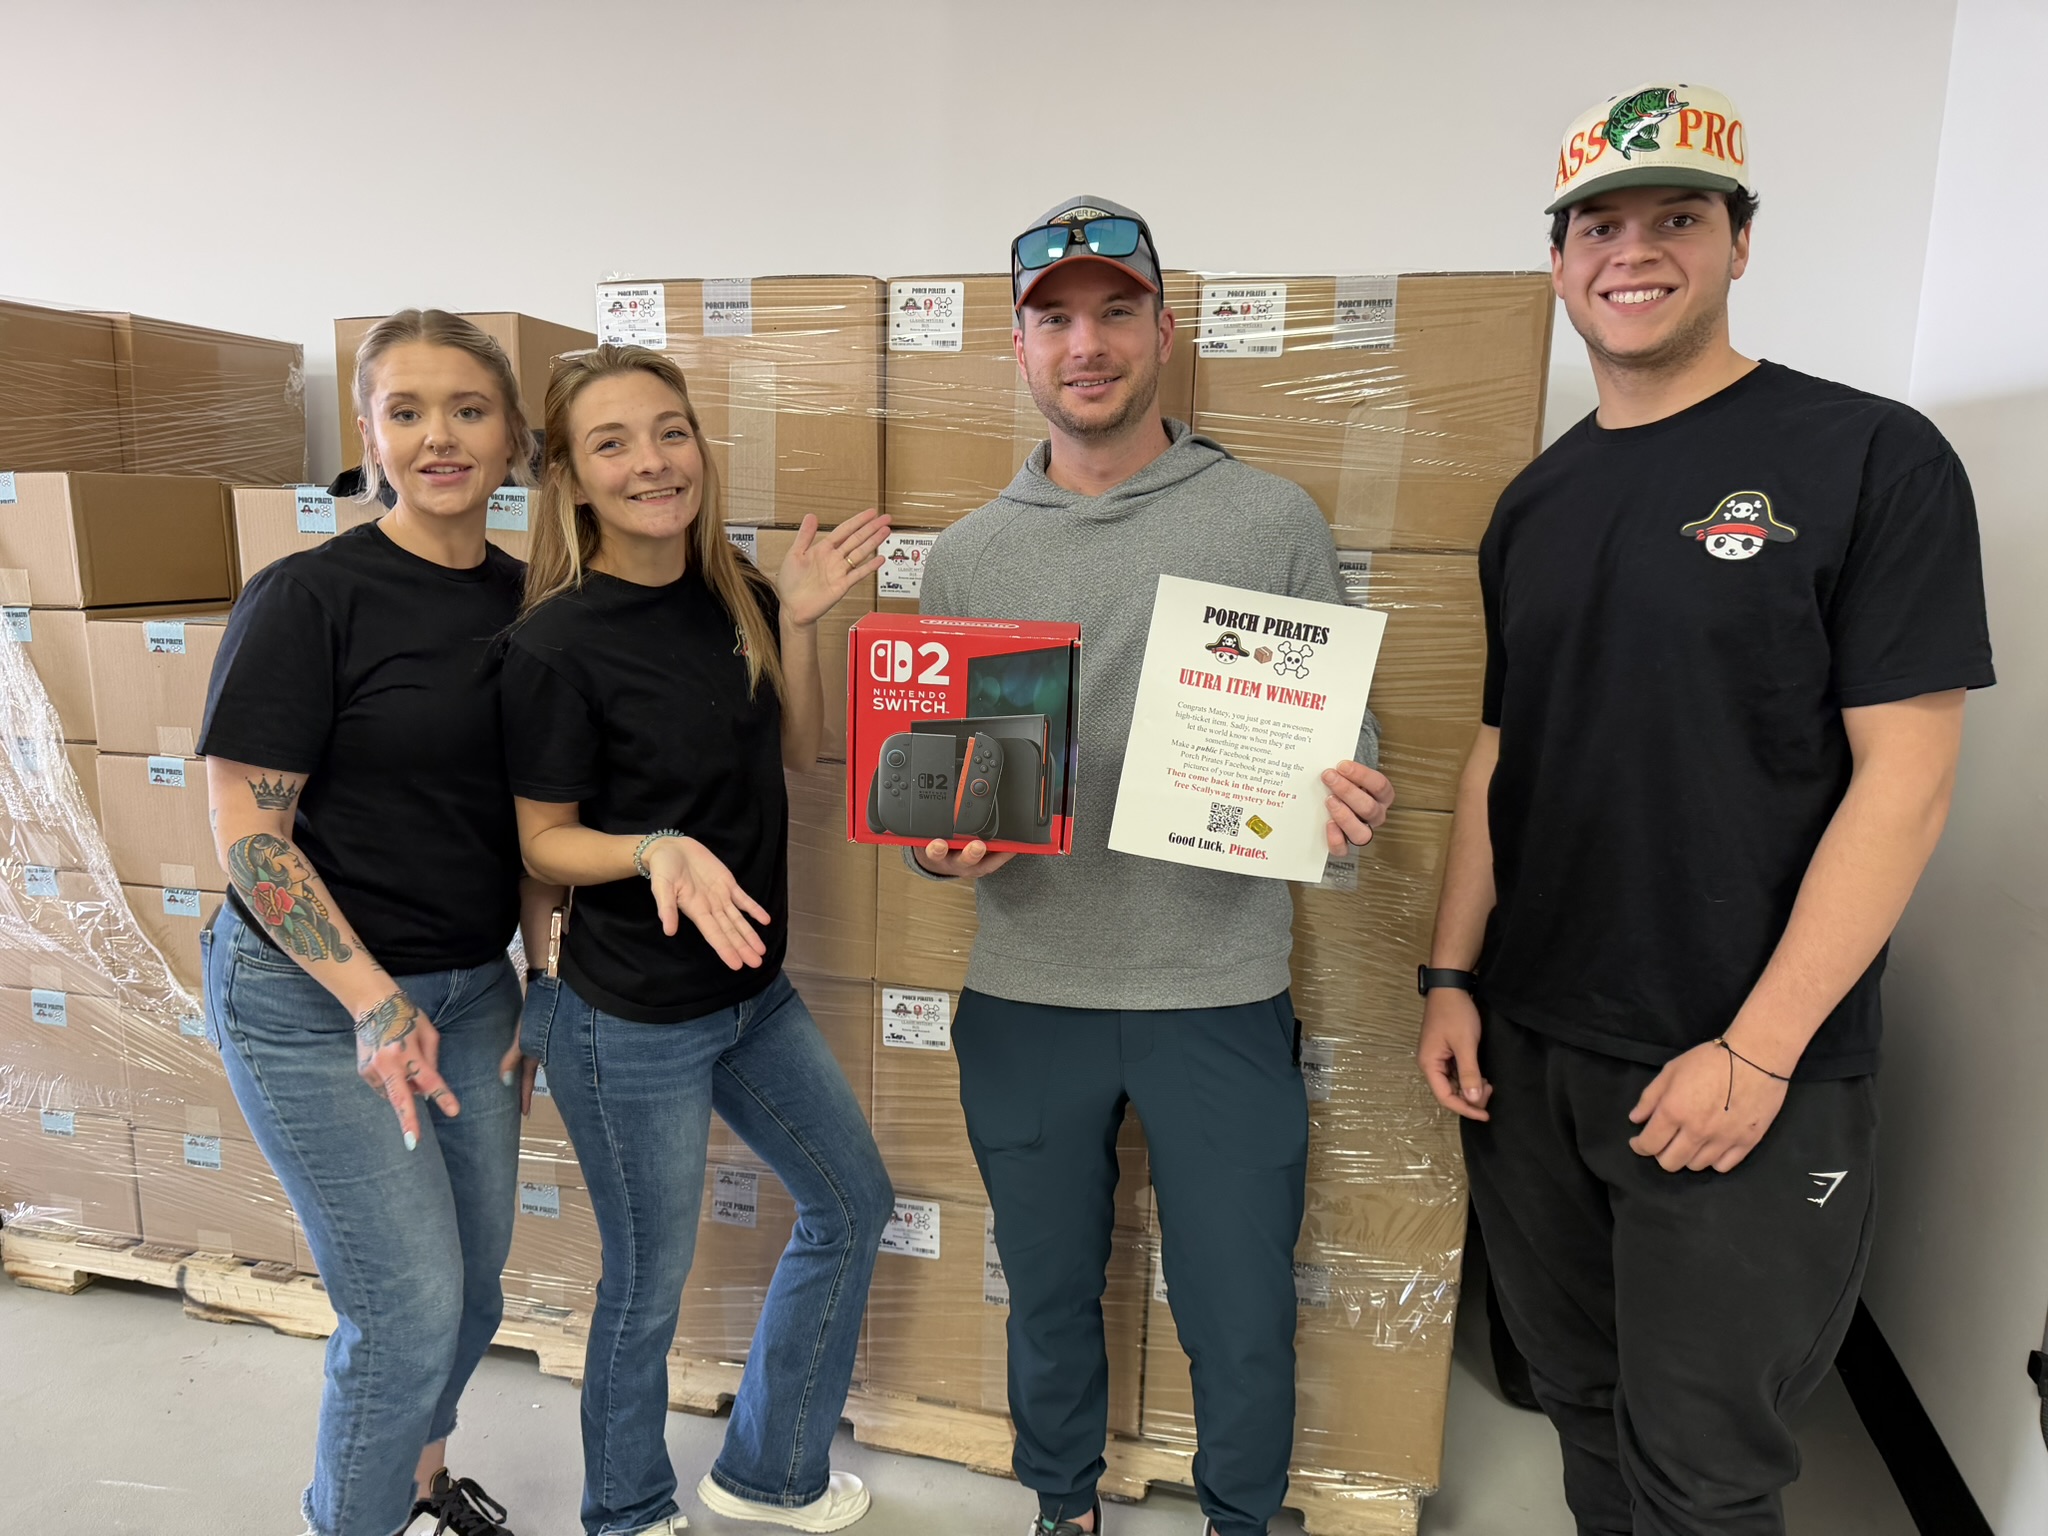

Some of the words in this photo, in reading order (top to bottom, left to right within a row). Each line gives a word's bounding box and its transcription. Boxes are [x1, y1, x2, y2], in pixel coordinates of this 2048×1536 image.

[1676, 108, 1744, 166] PRO
[1338, 300, 1362, 308] PORCH
[1364, 299, 1393, 307] PIRATES
[1339, 562, 1367, 570] PIRATES
[1204, 606, 1260, 632] PORCH
[1263, 617, 1330, 645] PIRATES
[918, 642, 950, 685] 2
[873, 688, 946, 699] NINTENDO
[1179, 668, 1224, 691] ULTRA
[1226, 677, 1262, 698] ITEM
[1265, 684, 1326, 710] WINNER!
[1175, 711, 1210, 724] high-ticket
[1212, 718, 1228, 726] item.
[1230, 721, 1250, 732] Sadly,
[1269, 729, 1292, 740] people
[1177, 701, 1207, 714] Congrats
[1208, 707, 1231, 718] Matey,
[1246, 714, 1259, 724] just
[1259, 718, 1271, 726] got
[1282, 723, 1313, 733] awesome
[1205, 736, 1239, 750] something
[1240, 744, 1272, 754] awesome.
[1208, 727, 1228, 736] world
[1229, 731, 1248, 739] know
[1249, 735, 1267, 744] when
[1268, 738, 1284, 748] they
[1171, 739, 1189, 748] Make
[1196, 744, 1217, 754] public
[1219, 749, 1250, 760] Facebook
[1252, 756, 1266, 764] post
[1180, 750, 1200, 760] Porch
[1201, 755, 1223, 764] Pirates
[1224, 759, 1256, 771] Facebook
[1257, 768, 1273, 776] page
[1275, 769, 1290, 778] with
[936, 774, 948, 789] 2
[1166, 767, 1186, 777] Then
[1188, 774, 1208, 782] come
[1210, 776, 1230, 786] back
[1242, 783, 1254, 791] the
[1256, 787, 1276, 795] store
[1278, 790, 1290, 798] for
[1183, 761, 1209, 772] pictures
[1263, 777, 1283, 787] prize!
[1174, 780, 1189, 789] free
[1190, 784, 1231, 798] Scallywag
[1232, 793, 1264, 805] mystery
[1266, 798, 1284, 807] box!
[1168, 832, 1196, 846] Good
[1198, 838, 1227, 853] Luck,
[1228, 843, 1270, 860] Pirates.
